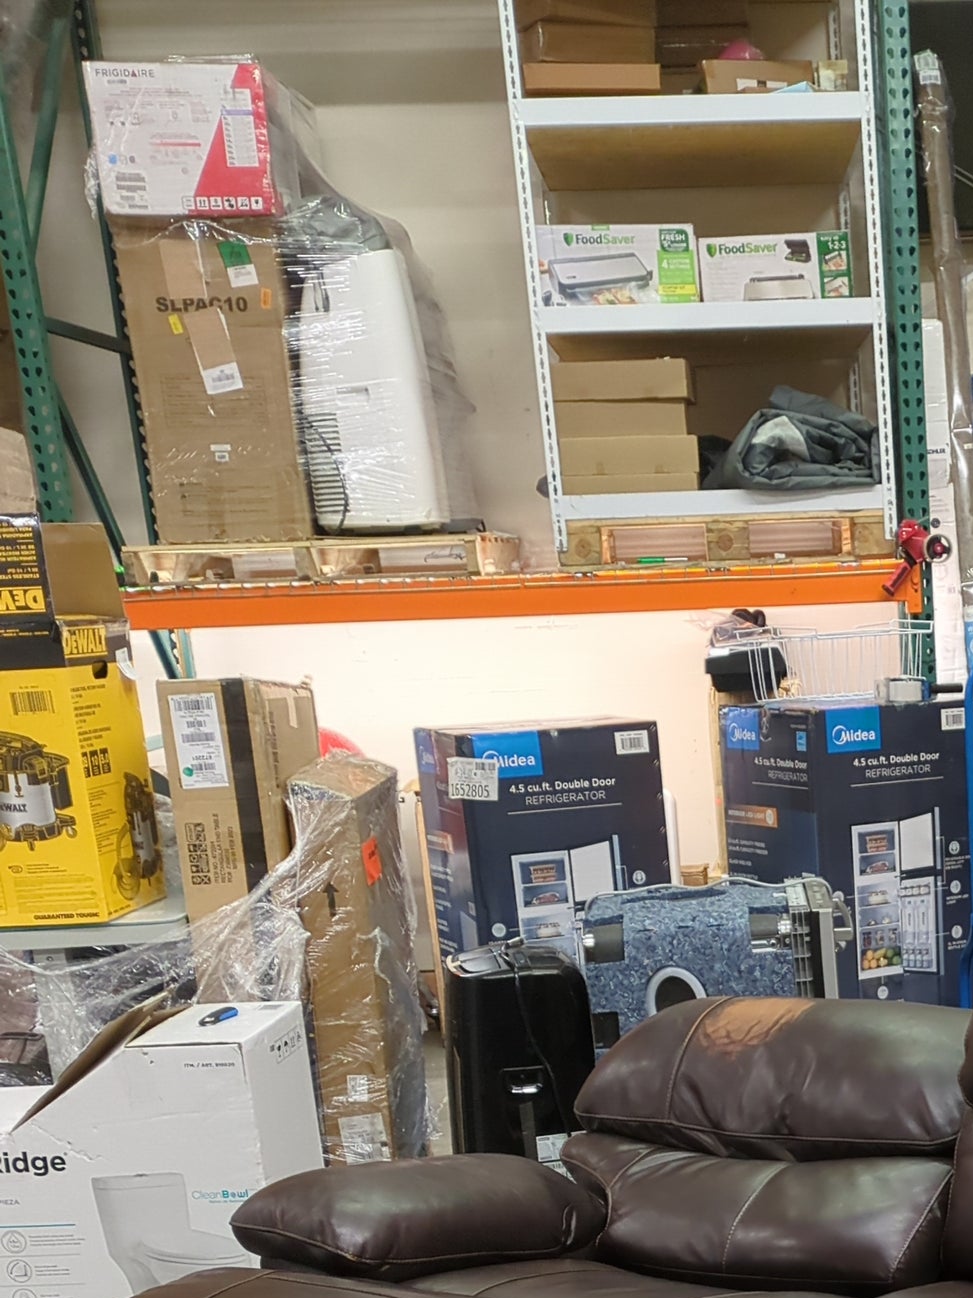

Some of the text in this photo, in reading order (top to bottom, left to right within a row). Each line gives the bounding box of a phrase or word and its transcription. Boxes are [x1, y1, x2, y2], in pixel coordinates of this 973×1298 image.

[95, 68, 155, 78] FRIGIDAIRE
[575, 232, 636, 245] FoodSaver
[828, 241, 847, 249] 1-2-3
[718, 242, 778, 255] FoodSaver
[155, 296, 249, 313] SLPAC10
[729, 722, 756, 742] Midea
[832, 725, 876, 745] Midea
[482, 750, 536, 768] Midea
[776, 759, 794, 768] Double
[794, 760, 808, 769] Door
[852, 757, 866, 768] 4.5
[889, 753, 919, 764] Double
[919, 751, 940, 761] Door
[768, 770, 808, 782] REFRIGERATOR
[865, 764, 931, 779] REFRIGERATOR
[451, 783, 490, 799] 1652805
[509, 782, 525, 794] 4.5
[555, 778, 590, 790] Double
[592, 777, 617, 787] Door
[525, 790, 606, 806] REFRIGERATOR
[192, 1188, 249, 1200] CleanBowl
